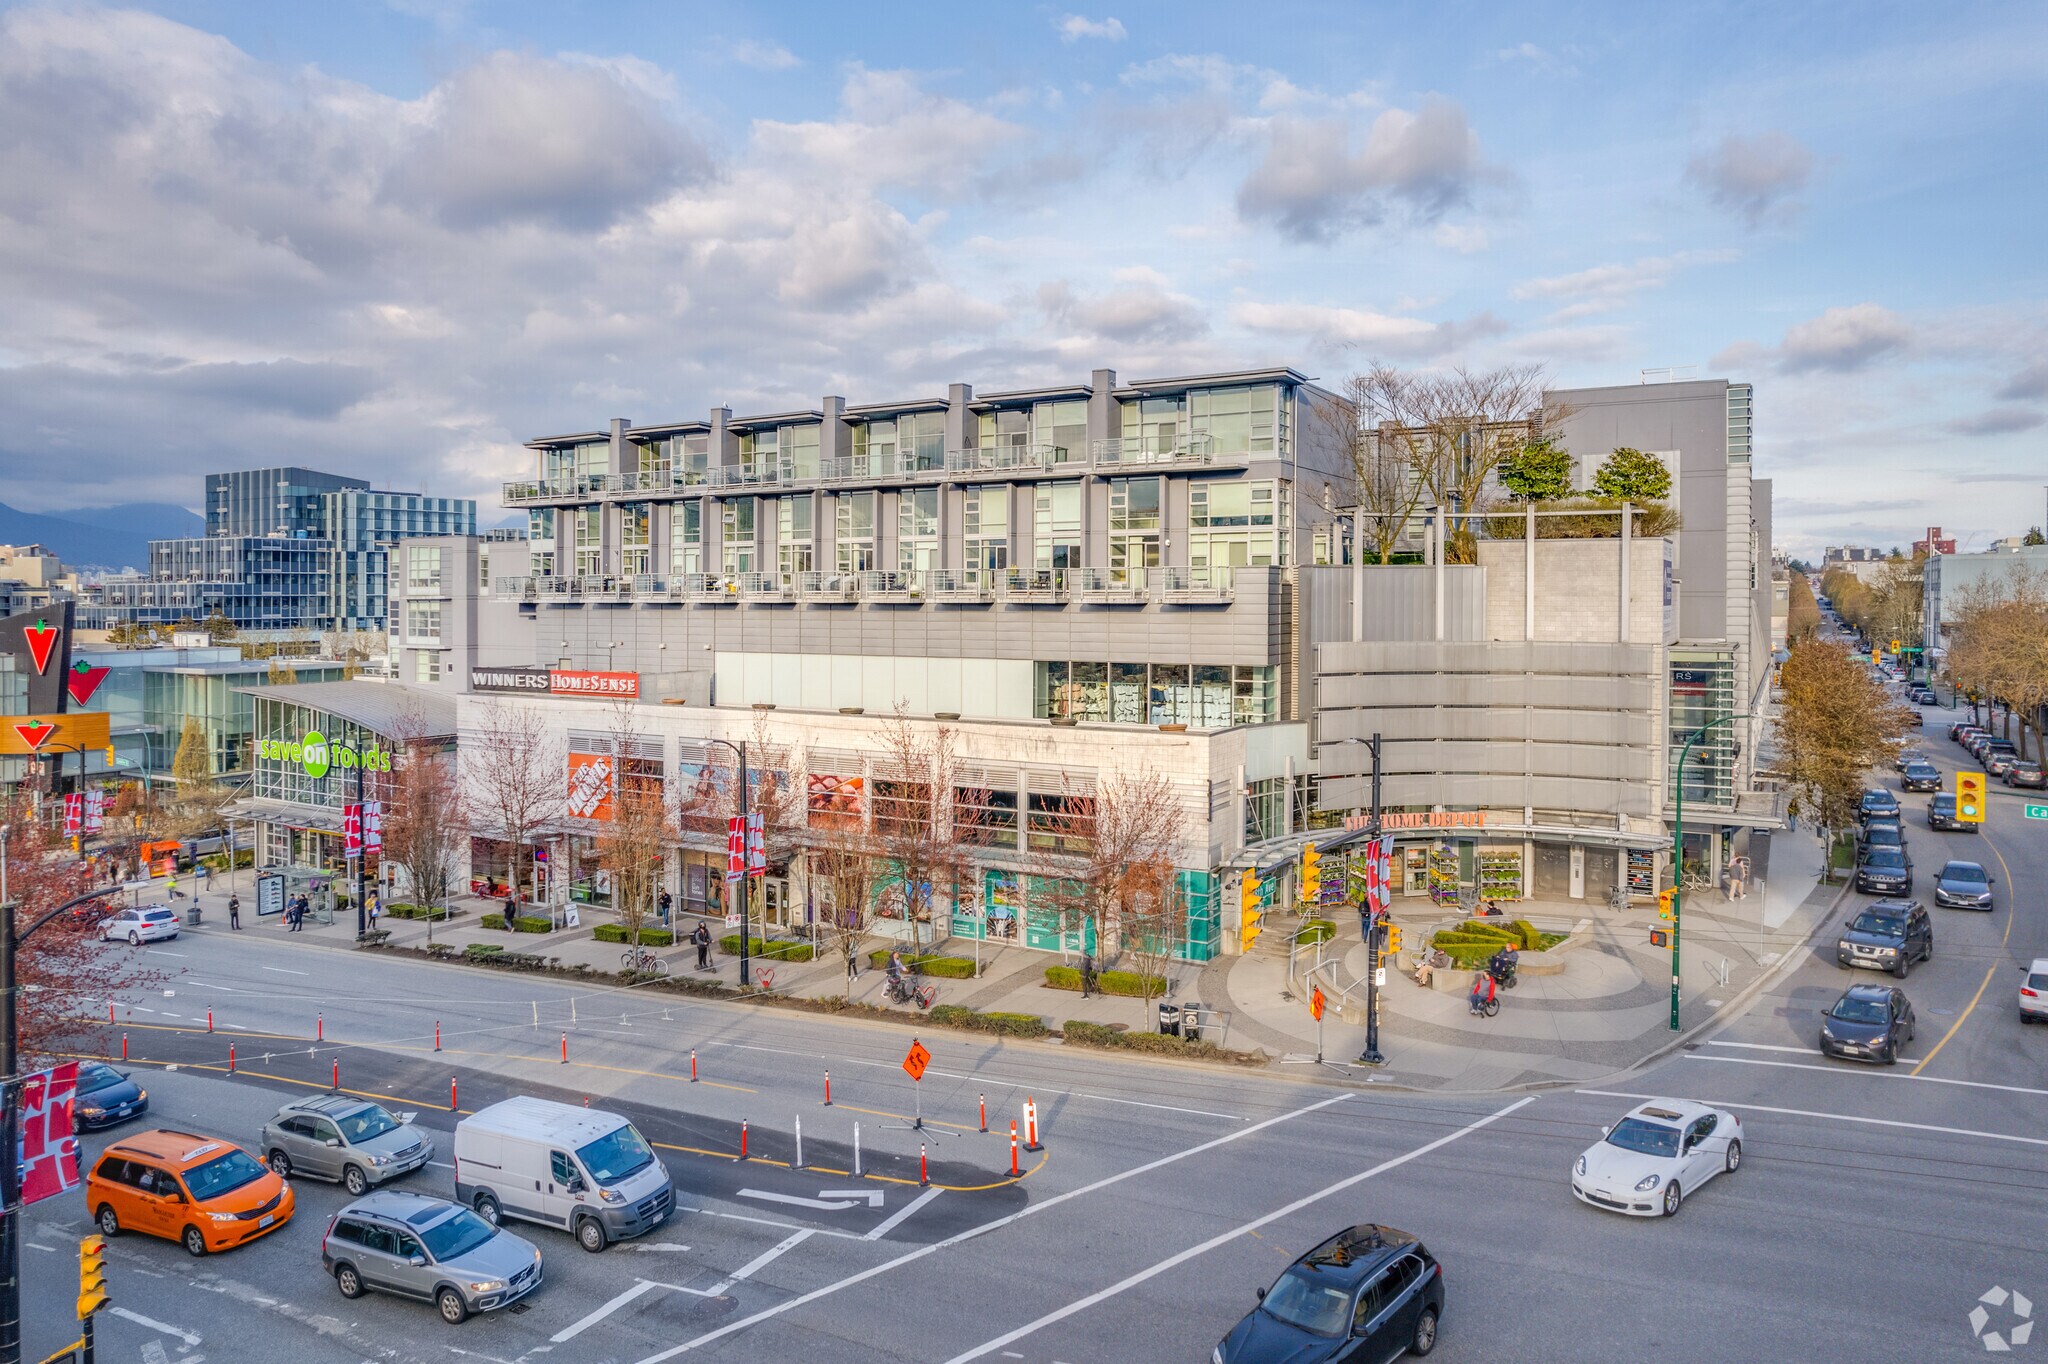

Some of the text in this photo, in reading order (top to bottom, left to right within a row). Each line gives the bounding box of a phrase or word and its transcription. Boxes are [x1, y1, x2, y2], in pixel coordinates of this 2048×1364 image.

[472, 672, 549, 689] WINNERS
[303, 744, 327, 765] on
[567, 757, 610, 815] HOME
[572, 762, 591, 787] THE
[583, 780, 609, 817] DEPOT
[1380, 812, 1425, 828] HOME
[1429, 811, 1488, 827] DEPOT
